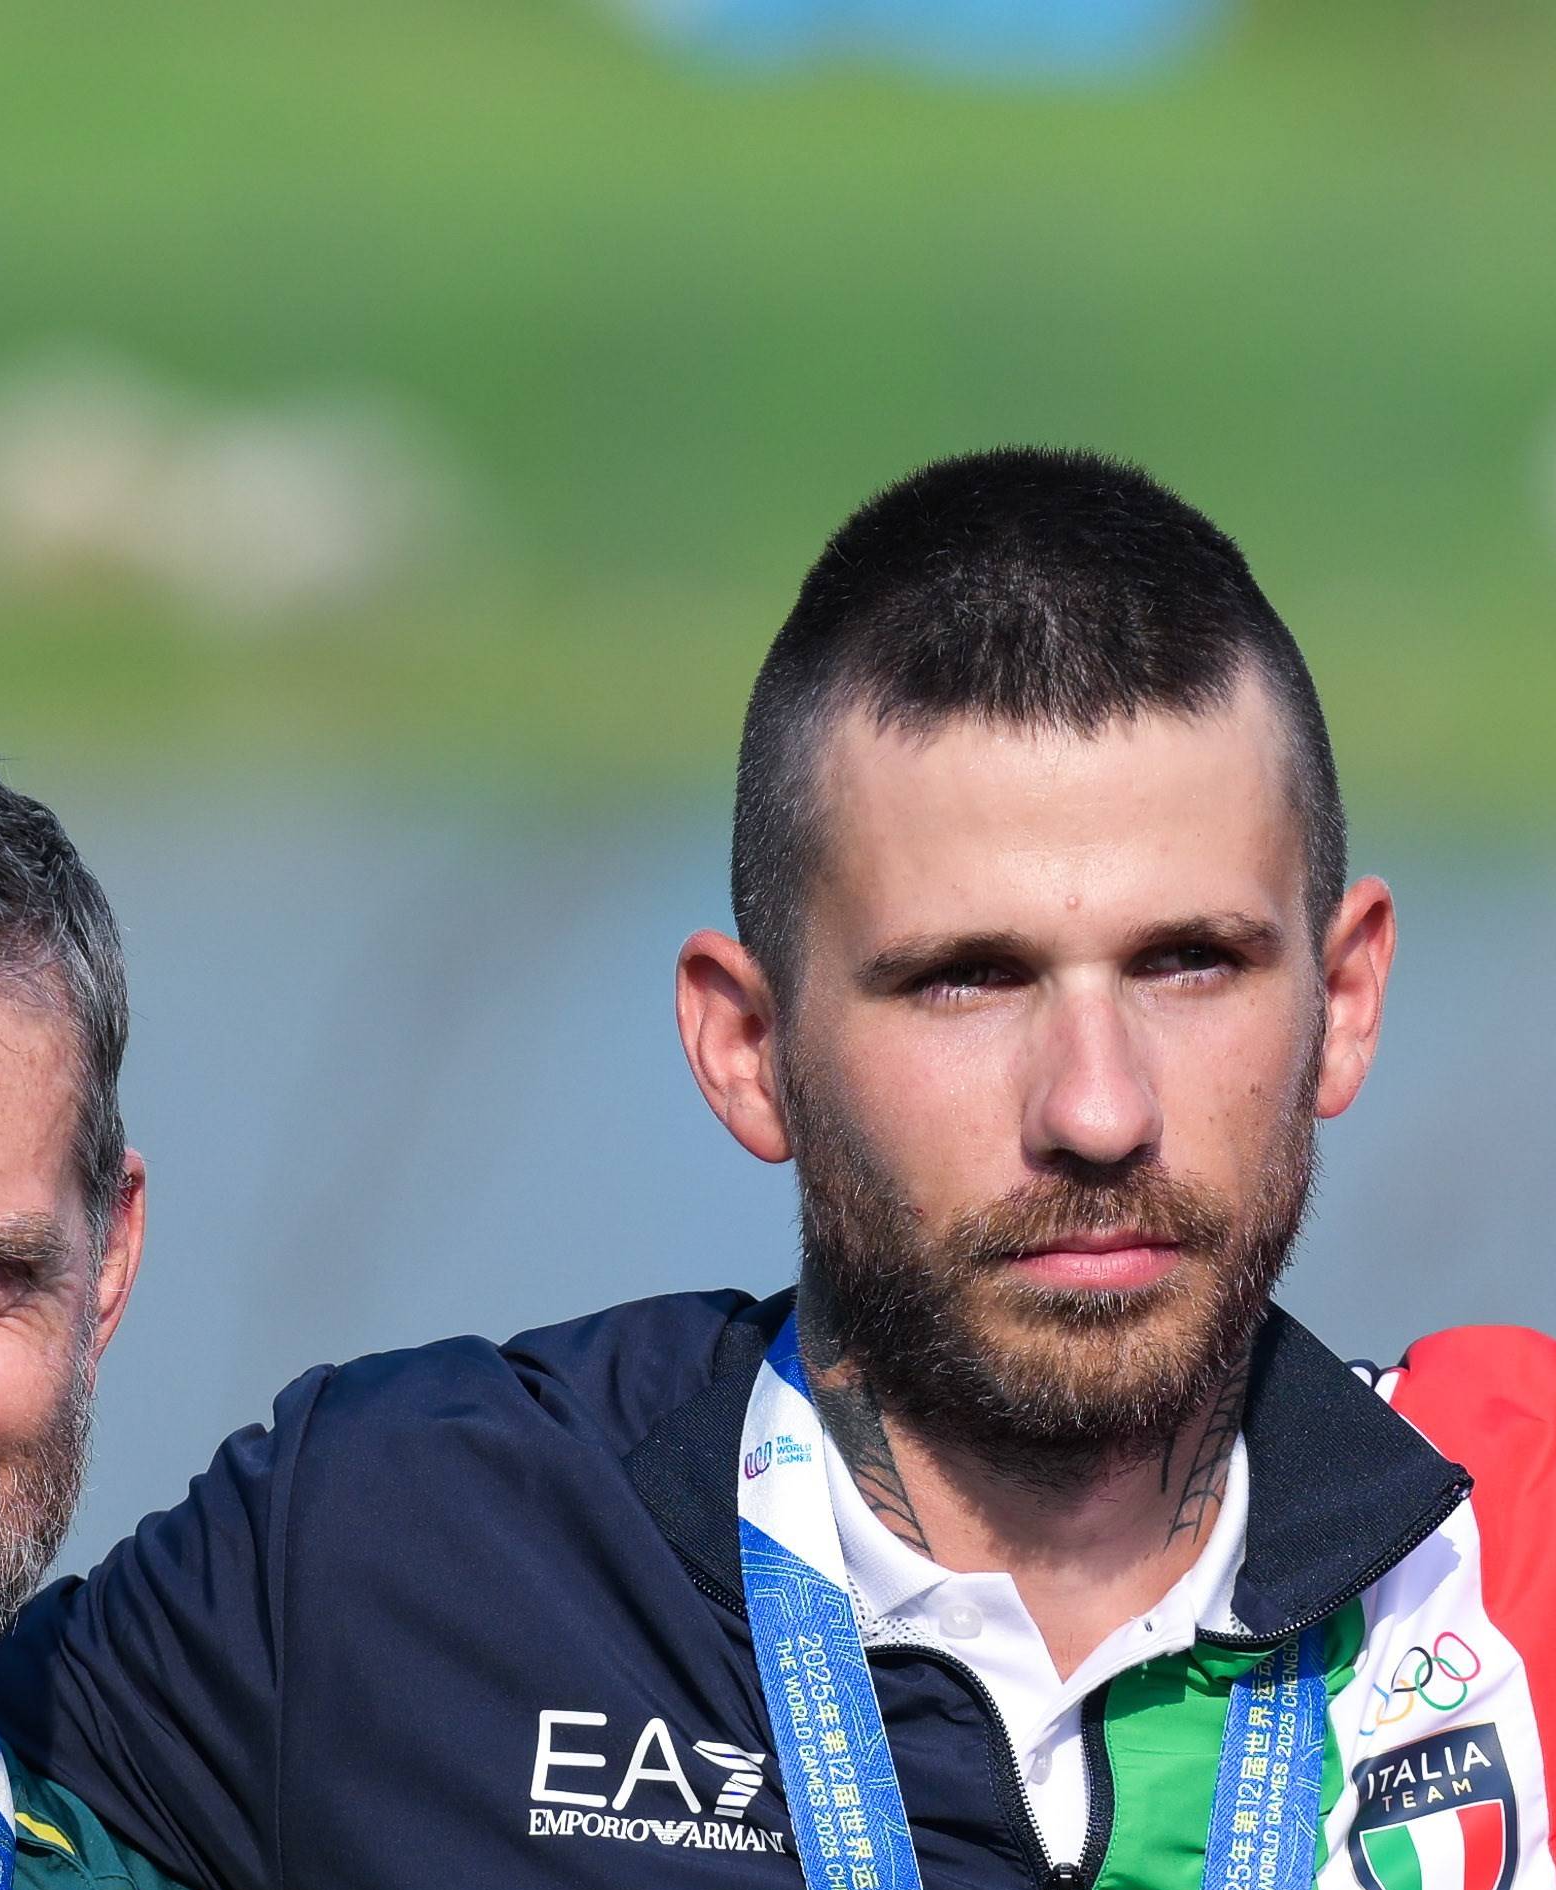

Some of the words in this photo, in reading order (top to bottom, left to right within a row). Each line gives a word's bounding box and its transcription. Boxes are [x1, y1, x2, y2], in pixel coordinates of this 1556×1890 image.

[775, 1637, 798, 1674] THE
[784, 1675, 813, 1742] WORLD
[1275, 1711, 1298, 1760] 2025
[798, 1743, 827, 1808] GAMES
[1366, 1740, 1493, 1800] ITALIA
[1263, 1762, 1290, 1830] GAMES
[1381, 1778, 1473, 1813] TEAM
[529, 1808, 651, 1842] EMPORIO
[683, 1820, 786, 1854] ARMANI
[813, 1812, 839, 1860] 2025
